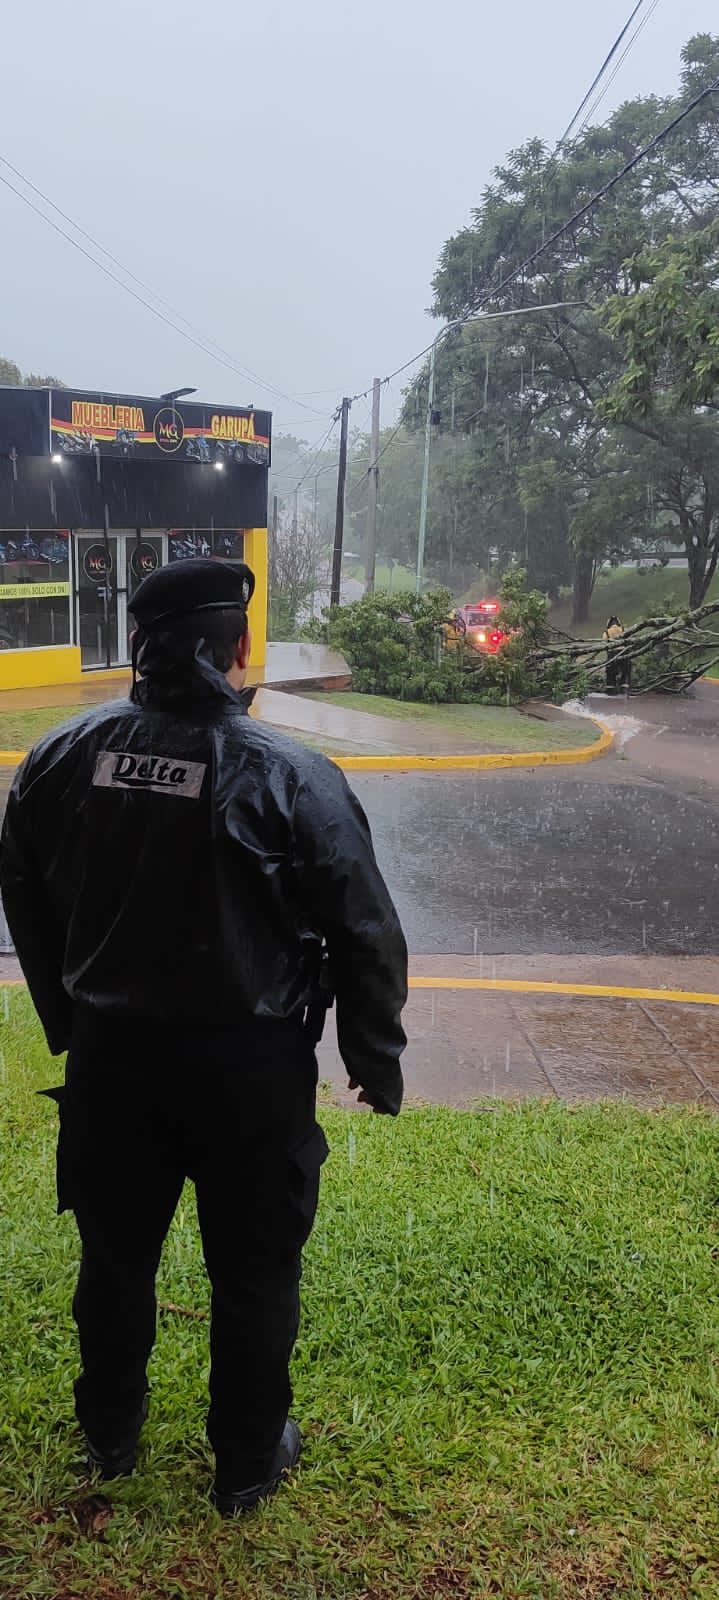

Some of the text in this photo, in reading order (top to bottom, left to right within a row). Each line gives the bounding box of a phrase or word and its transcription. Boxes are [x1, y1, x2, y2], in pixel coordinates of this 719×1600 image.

[72, 401, 255, 439] MUEBLERIA GARUPÁ
[112, 754, 187, 784] Delta
